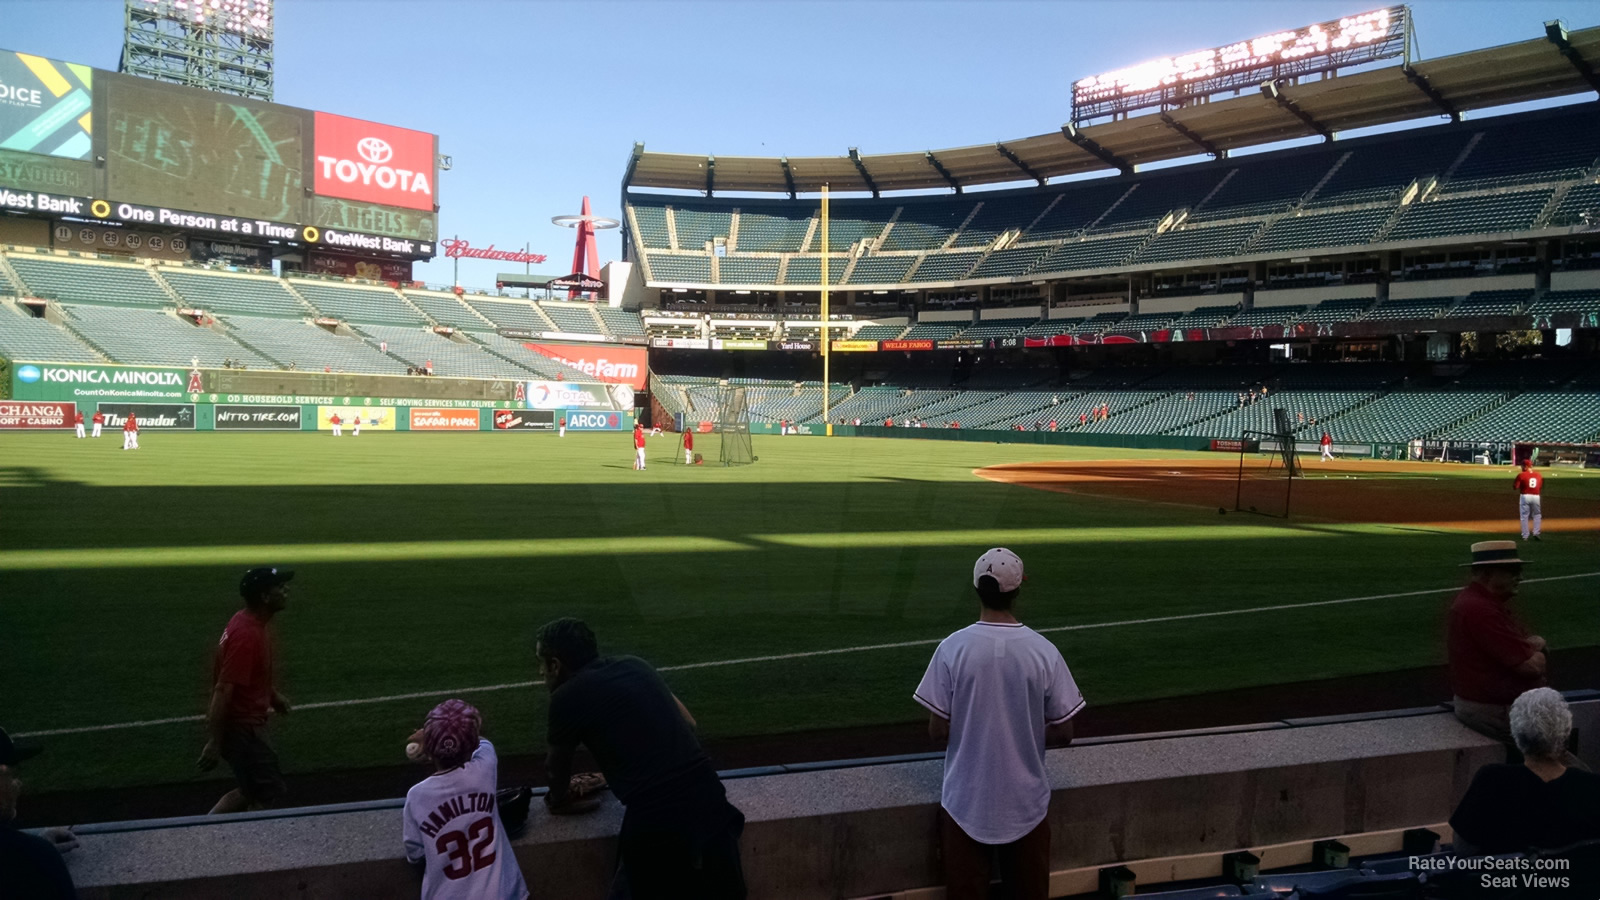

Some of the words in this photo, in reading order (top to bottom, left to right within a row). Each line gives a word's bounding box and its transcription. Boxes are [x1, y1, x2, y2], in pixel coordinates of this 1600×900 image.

[318, 155, 430, 195] TOYOTA
[38, 193, 80, 214] Bank
[118, 203, 154, 222] One
[159, 208, 216, 230] Person
[220, 218, 239, 231] at
[242, 221, 252, 233] a
[255, 220, 294, 239] Time
[327, 201, 403, 234] ANGELS
[60, 228, 68, 238] 11
[82, 230, 93, 240] 26
[128, 236, 139, 245] 30
[150, 238, 162, 247] 42
[173, 240, 184, 249] 50
[325, 230, 381, 249] OneWest
[383, 237, 412, 253] Bank
[440, 238, 548, 264] Budweiser
[781, 342, 793, 350] Yard
[794, 342, 811, 350] House
[885, 341, 907, 349] WELLS
[908, 341, 932, 349] FARGO
[1002, 338, 1016, 346] 5:08
[43, 368, 110, 383] KONICA
[112, 371, 183, 386] MINOLTA
[74, 388, 182, 398] CountOnKonicaMinolta.com
[243, 395, 293, 403] HOUSEHOLD
[380, 398, 423, 406] SELF-MOVING
[425, 399, 453, 407] SERVICES
[454, 400, 471, 408] THAT
[0, 405, 64, 416] CHANGA
[27, 417, 63, 425] CASINO
[218, 411, 250, 422] NITTO
[252, 412, 299, 422] TIRE.COM
[569, 414, 606, 427] ARCO
[413, 417, 449, 427] SAFARI
[450, 418, 476, 427] PARK
[1529, 477, 1537, 488] 8
[420, 792, 494, 838] HAMILTON
[435, 816, 496, 880] 32
